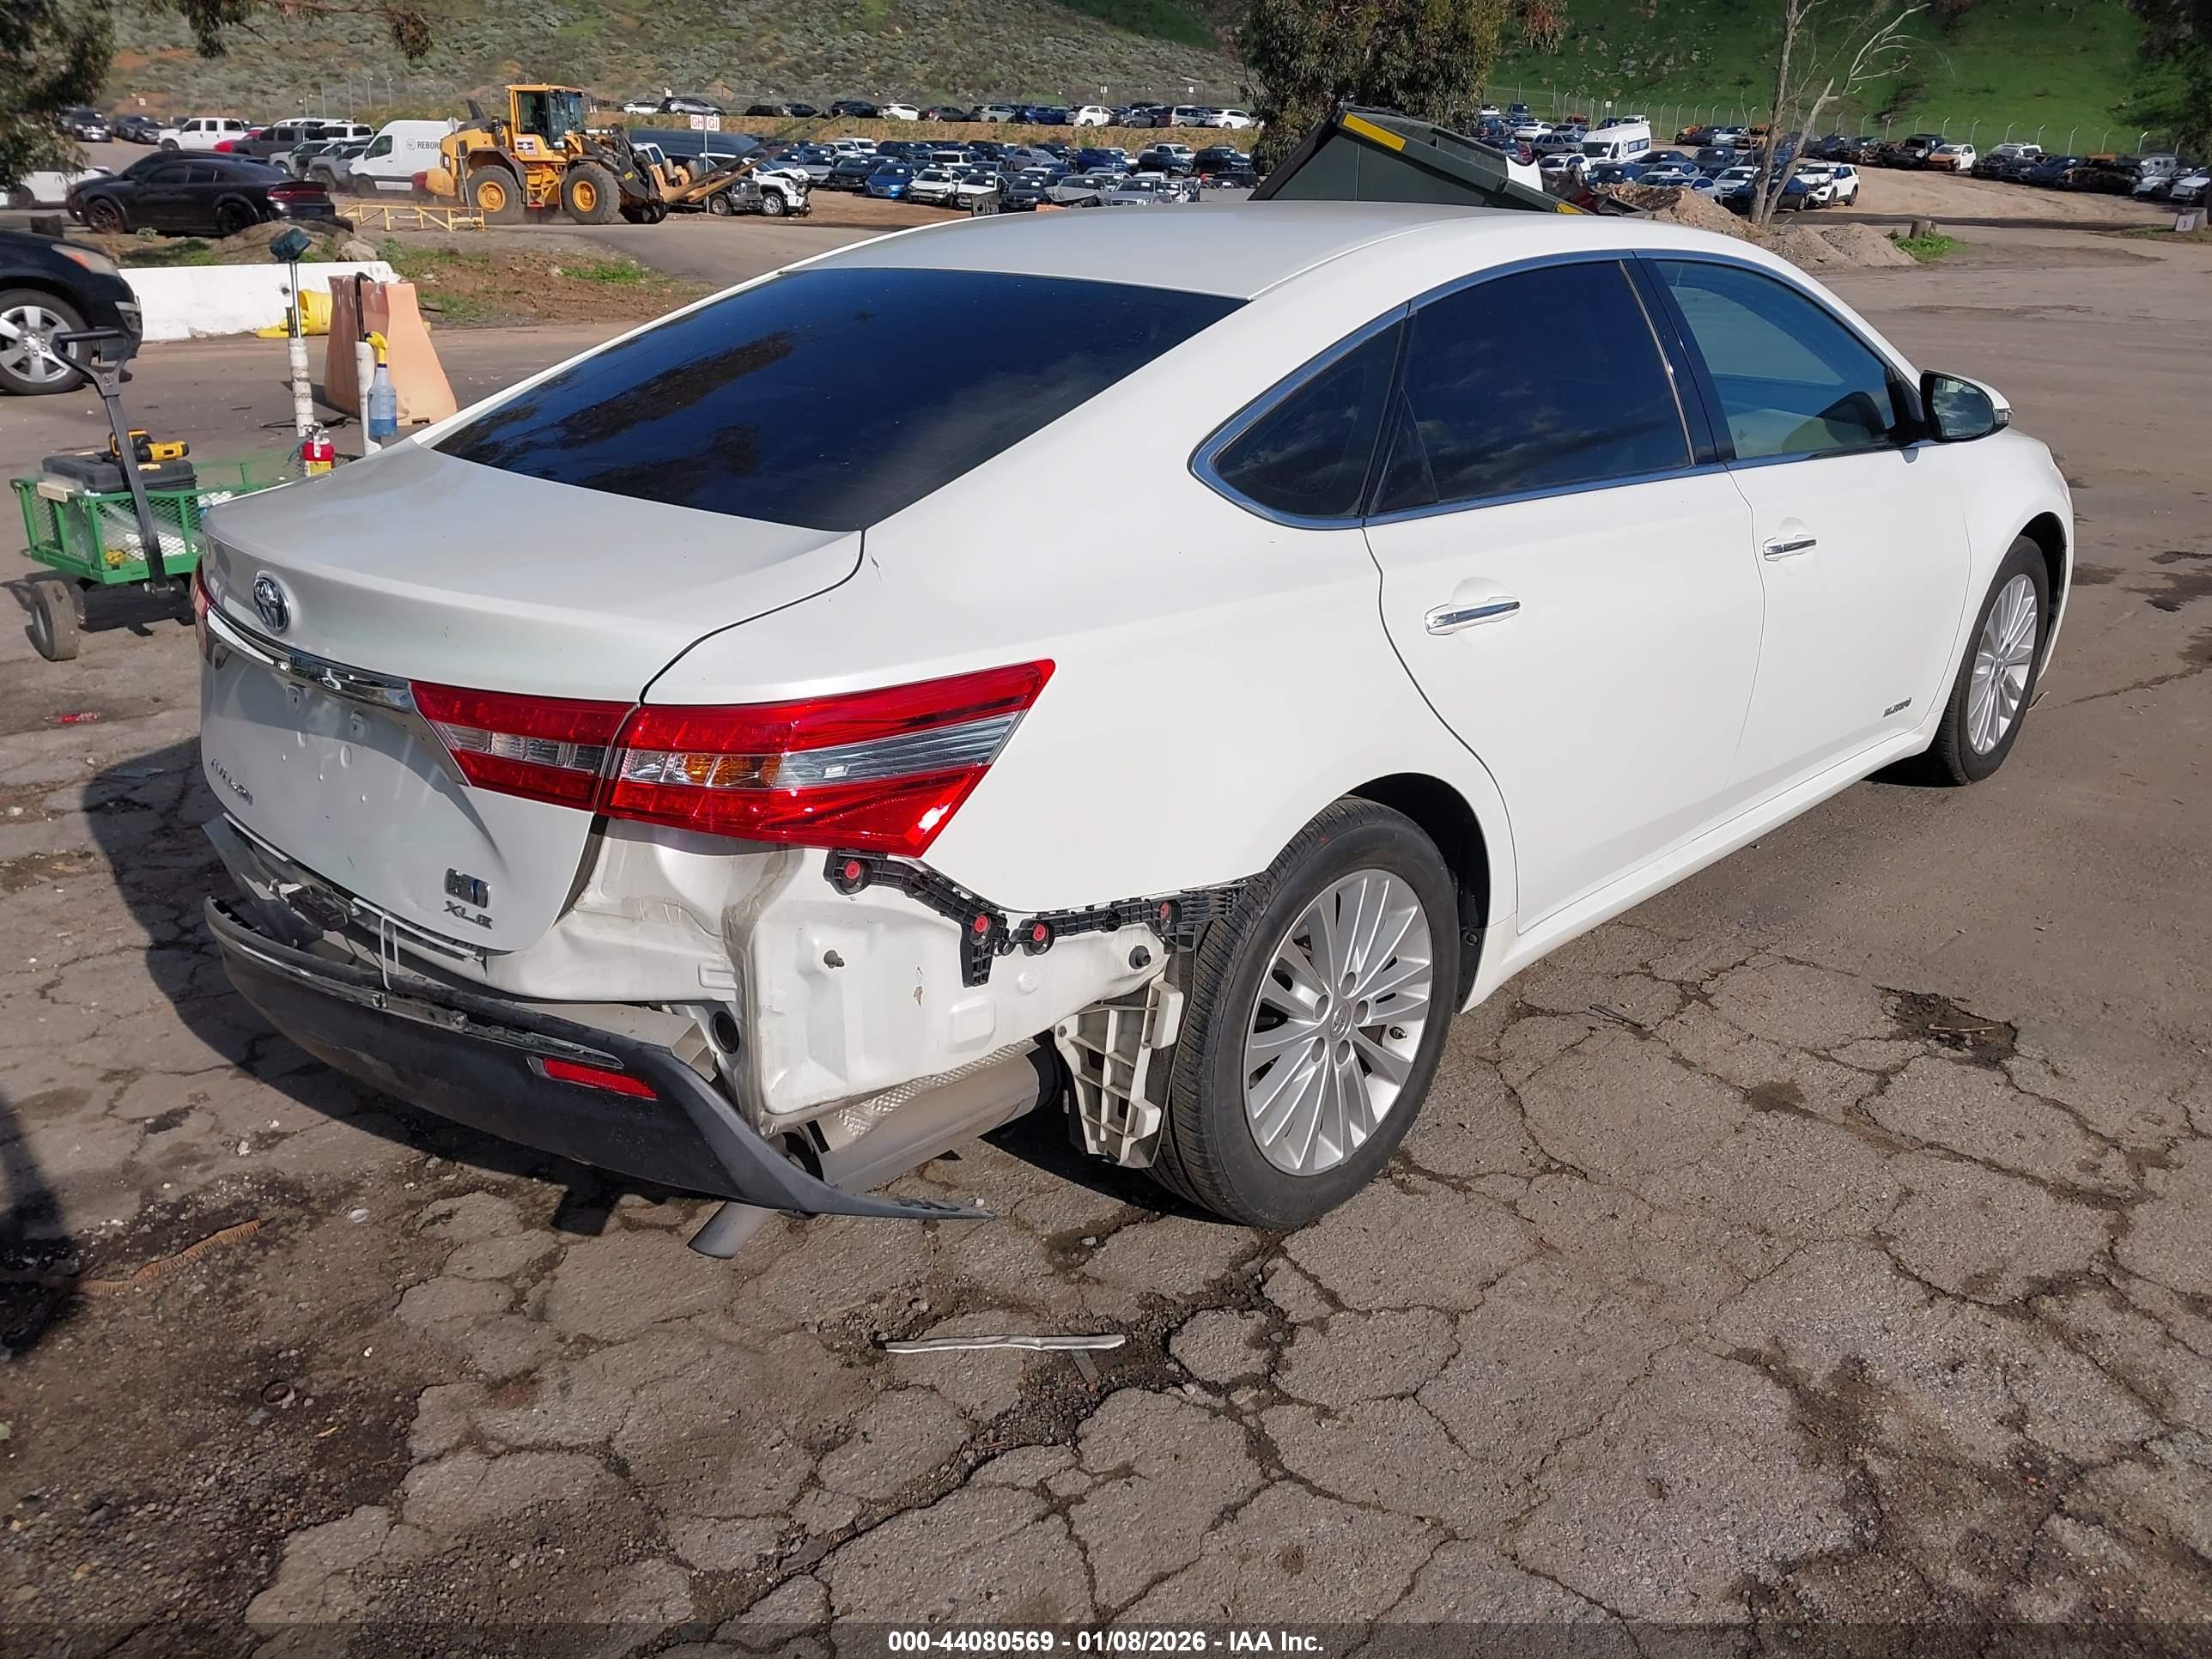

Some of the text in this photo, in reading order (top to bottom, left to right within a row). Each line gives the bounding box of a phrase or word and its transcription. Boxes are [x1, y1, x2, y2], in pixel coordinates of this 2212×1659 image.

[691, 117, 702, 128] GH
[708, 118, 718, 130] GI
[442, 899, 493, 930] XLE
